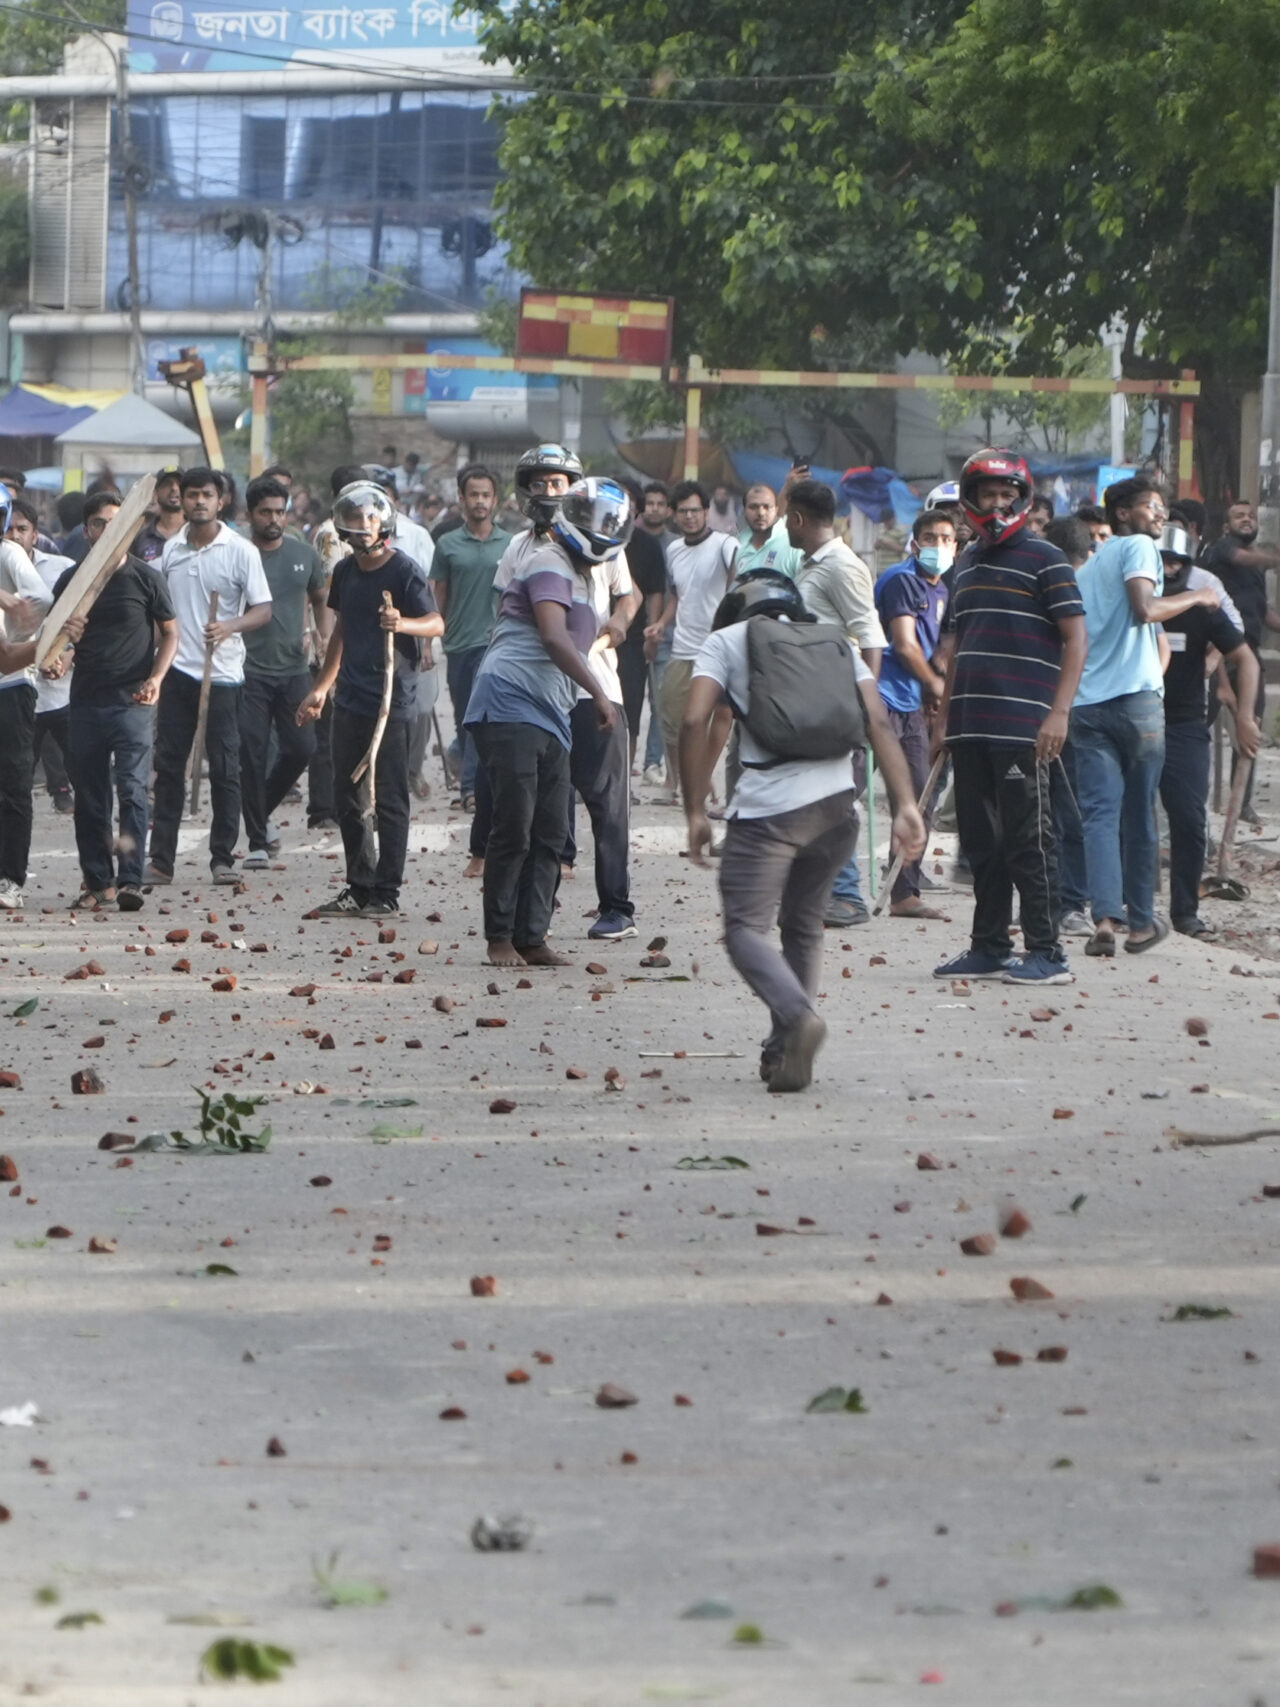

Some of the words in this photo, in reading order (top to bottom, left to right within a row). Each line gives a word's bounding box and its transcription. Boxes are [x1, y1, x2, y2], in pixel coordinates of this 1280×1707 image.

[191, 7, 291, 42] জনতা
[301, 8, 398, 41] ব্যাংক
[408, 0, 480, 38] পিএ
